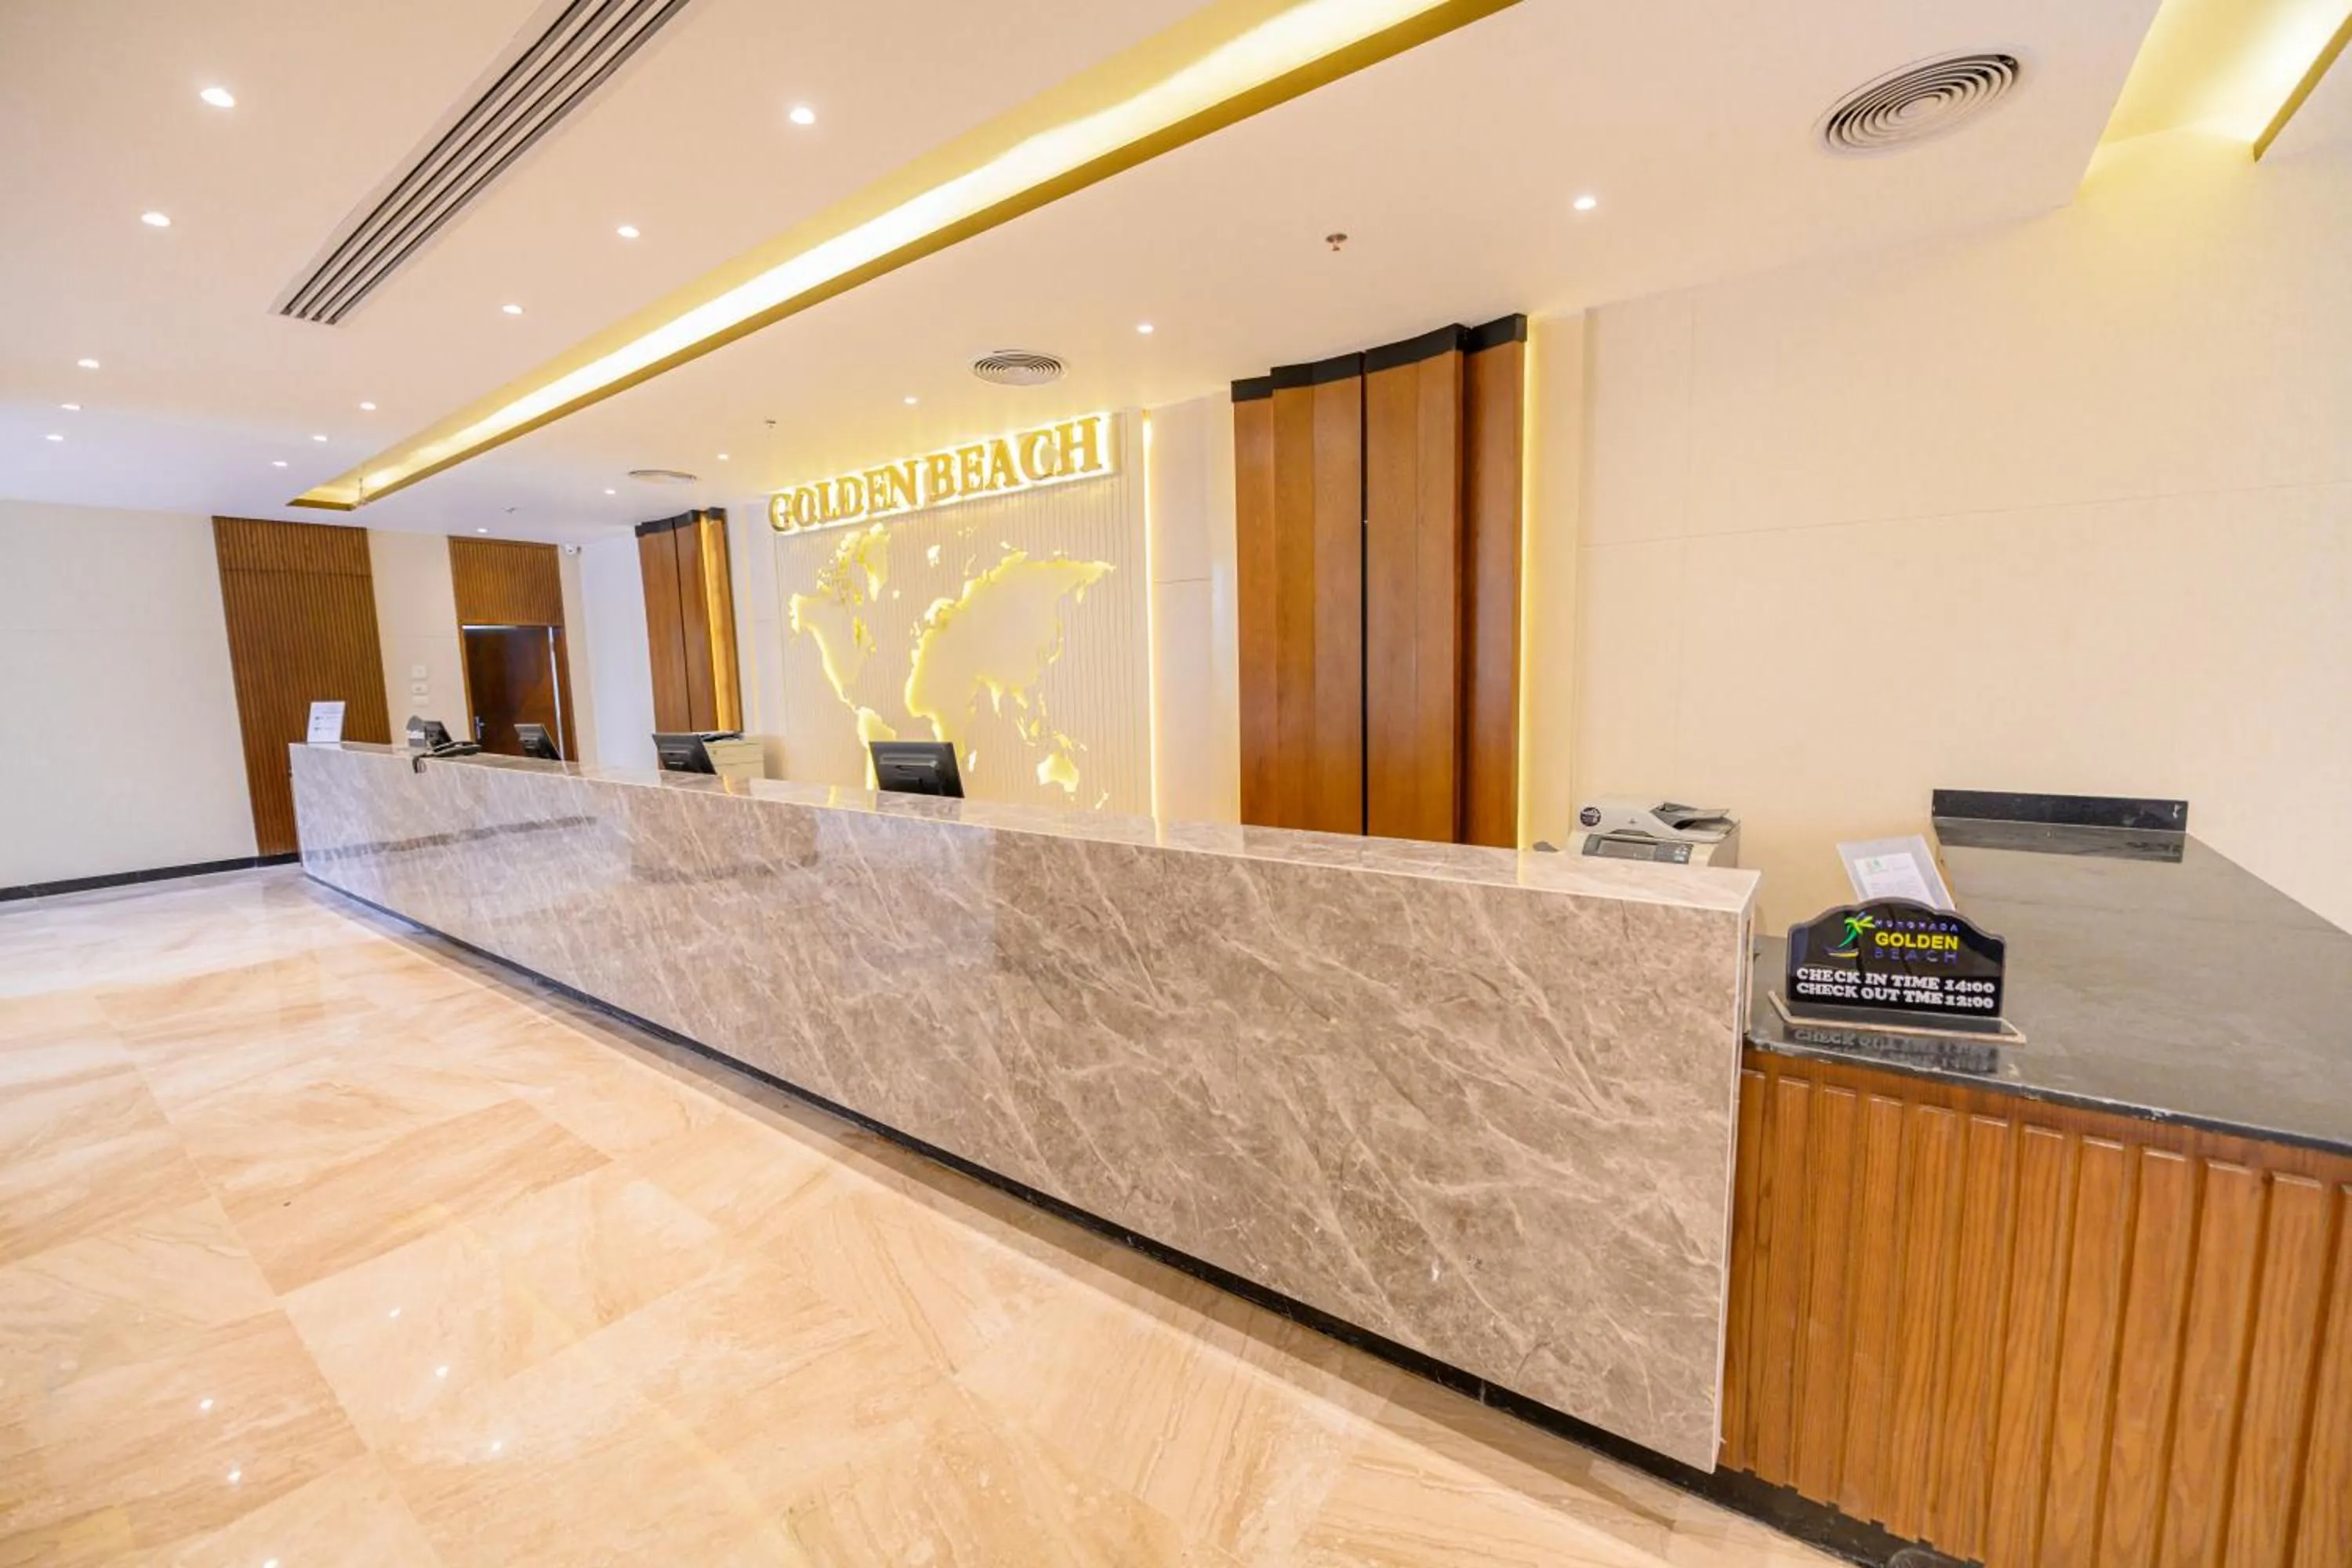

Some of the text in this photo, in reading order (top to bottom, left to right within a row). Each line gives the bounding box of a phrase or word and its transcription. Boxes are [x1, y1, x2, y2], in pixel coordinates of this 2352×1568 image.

[768, 416, 1104, 532] GOLDEN BEACH
[1875, 931, 1958, 950] GOLDEN
[1875, 947, 1958, 965] BEACH
[1796, 967, 1995, 993] CHECK IN TIME 14:00
[1796, 982, 1994, 1009] CHECK OUT TME 12:00
